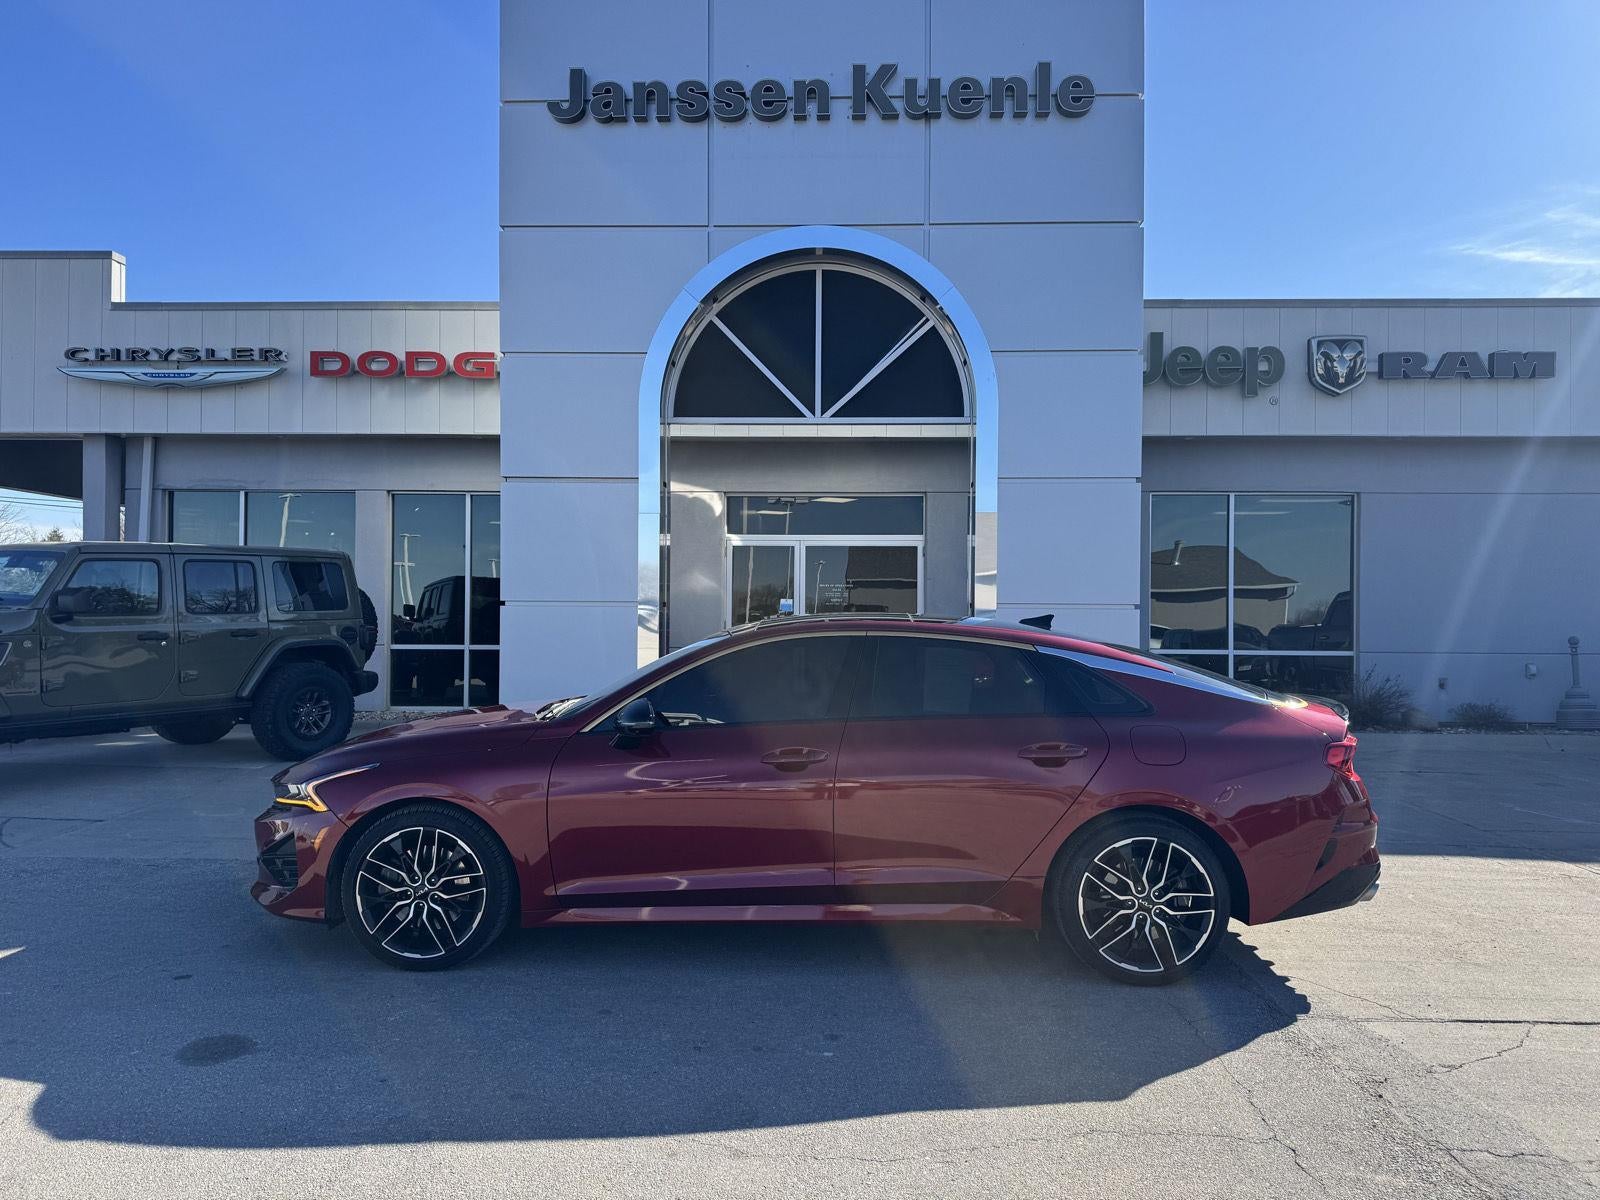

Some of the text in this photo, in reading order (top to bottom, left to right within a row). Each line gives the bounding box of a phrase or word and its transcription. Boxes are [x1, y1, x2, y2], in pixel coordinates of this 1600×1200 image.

[547, 61, 1096, 124] Janssen Kuenle
[64, 346, 286, 363] CHRYSLER
[309, 350, 498, 379] DODG
[1143, 331, 1285, 397] Jeep
[1378, 351, 1557, 379] RAM
